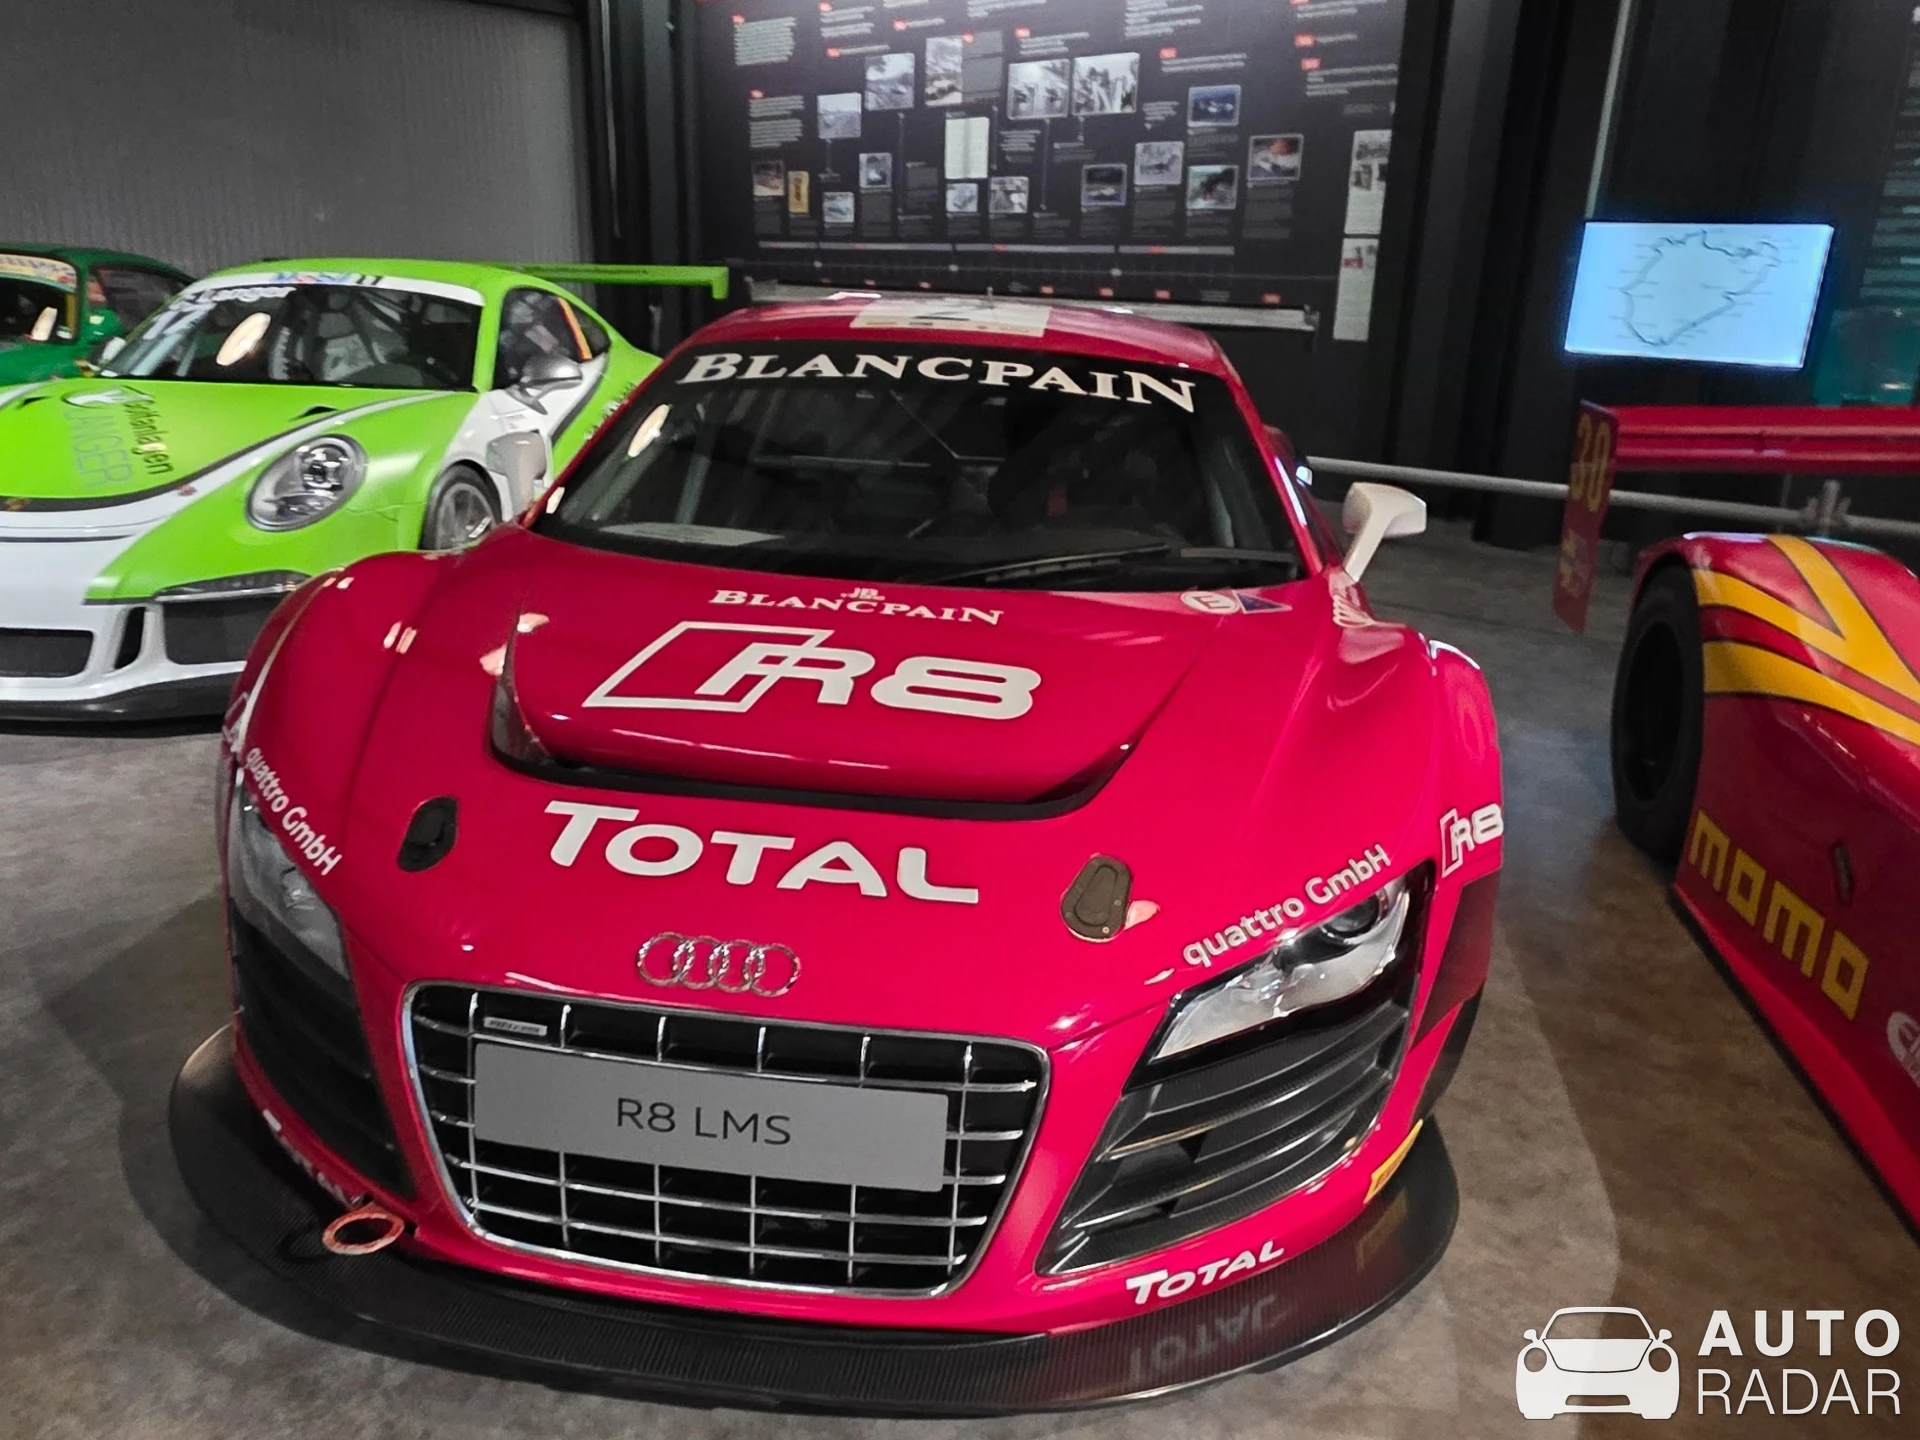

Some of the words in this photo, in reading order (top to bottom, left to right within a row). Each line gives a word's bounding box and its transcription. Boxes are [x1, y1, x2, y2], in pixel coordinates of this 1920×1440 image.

[678, 352, 1196, 413] BLANCPAIN
[709, 589, 1004, 625] BLANCPAIN
[694, 642, 1042, 720] R8
[244, 747, 290, 813] quattro
[281, 806, 343, 876] GmbH
[1449, 803, 1504, 861] R8
[543, 799, 980, 904] TOTAL
[1182, 897, 1305, 968] quattro
[1304, 843, 1392, 905] GmbH
[617, 1097, 677, 1134] R8
[694, 1105, 792, 1146] LMS
[1125, 1240, 1285, 1305] TOTAL
